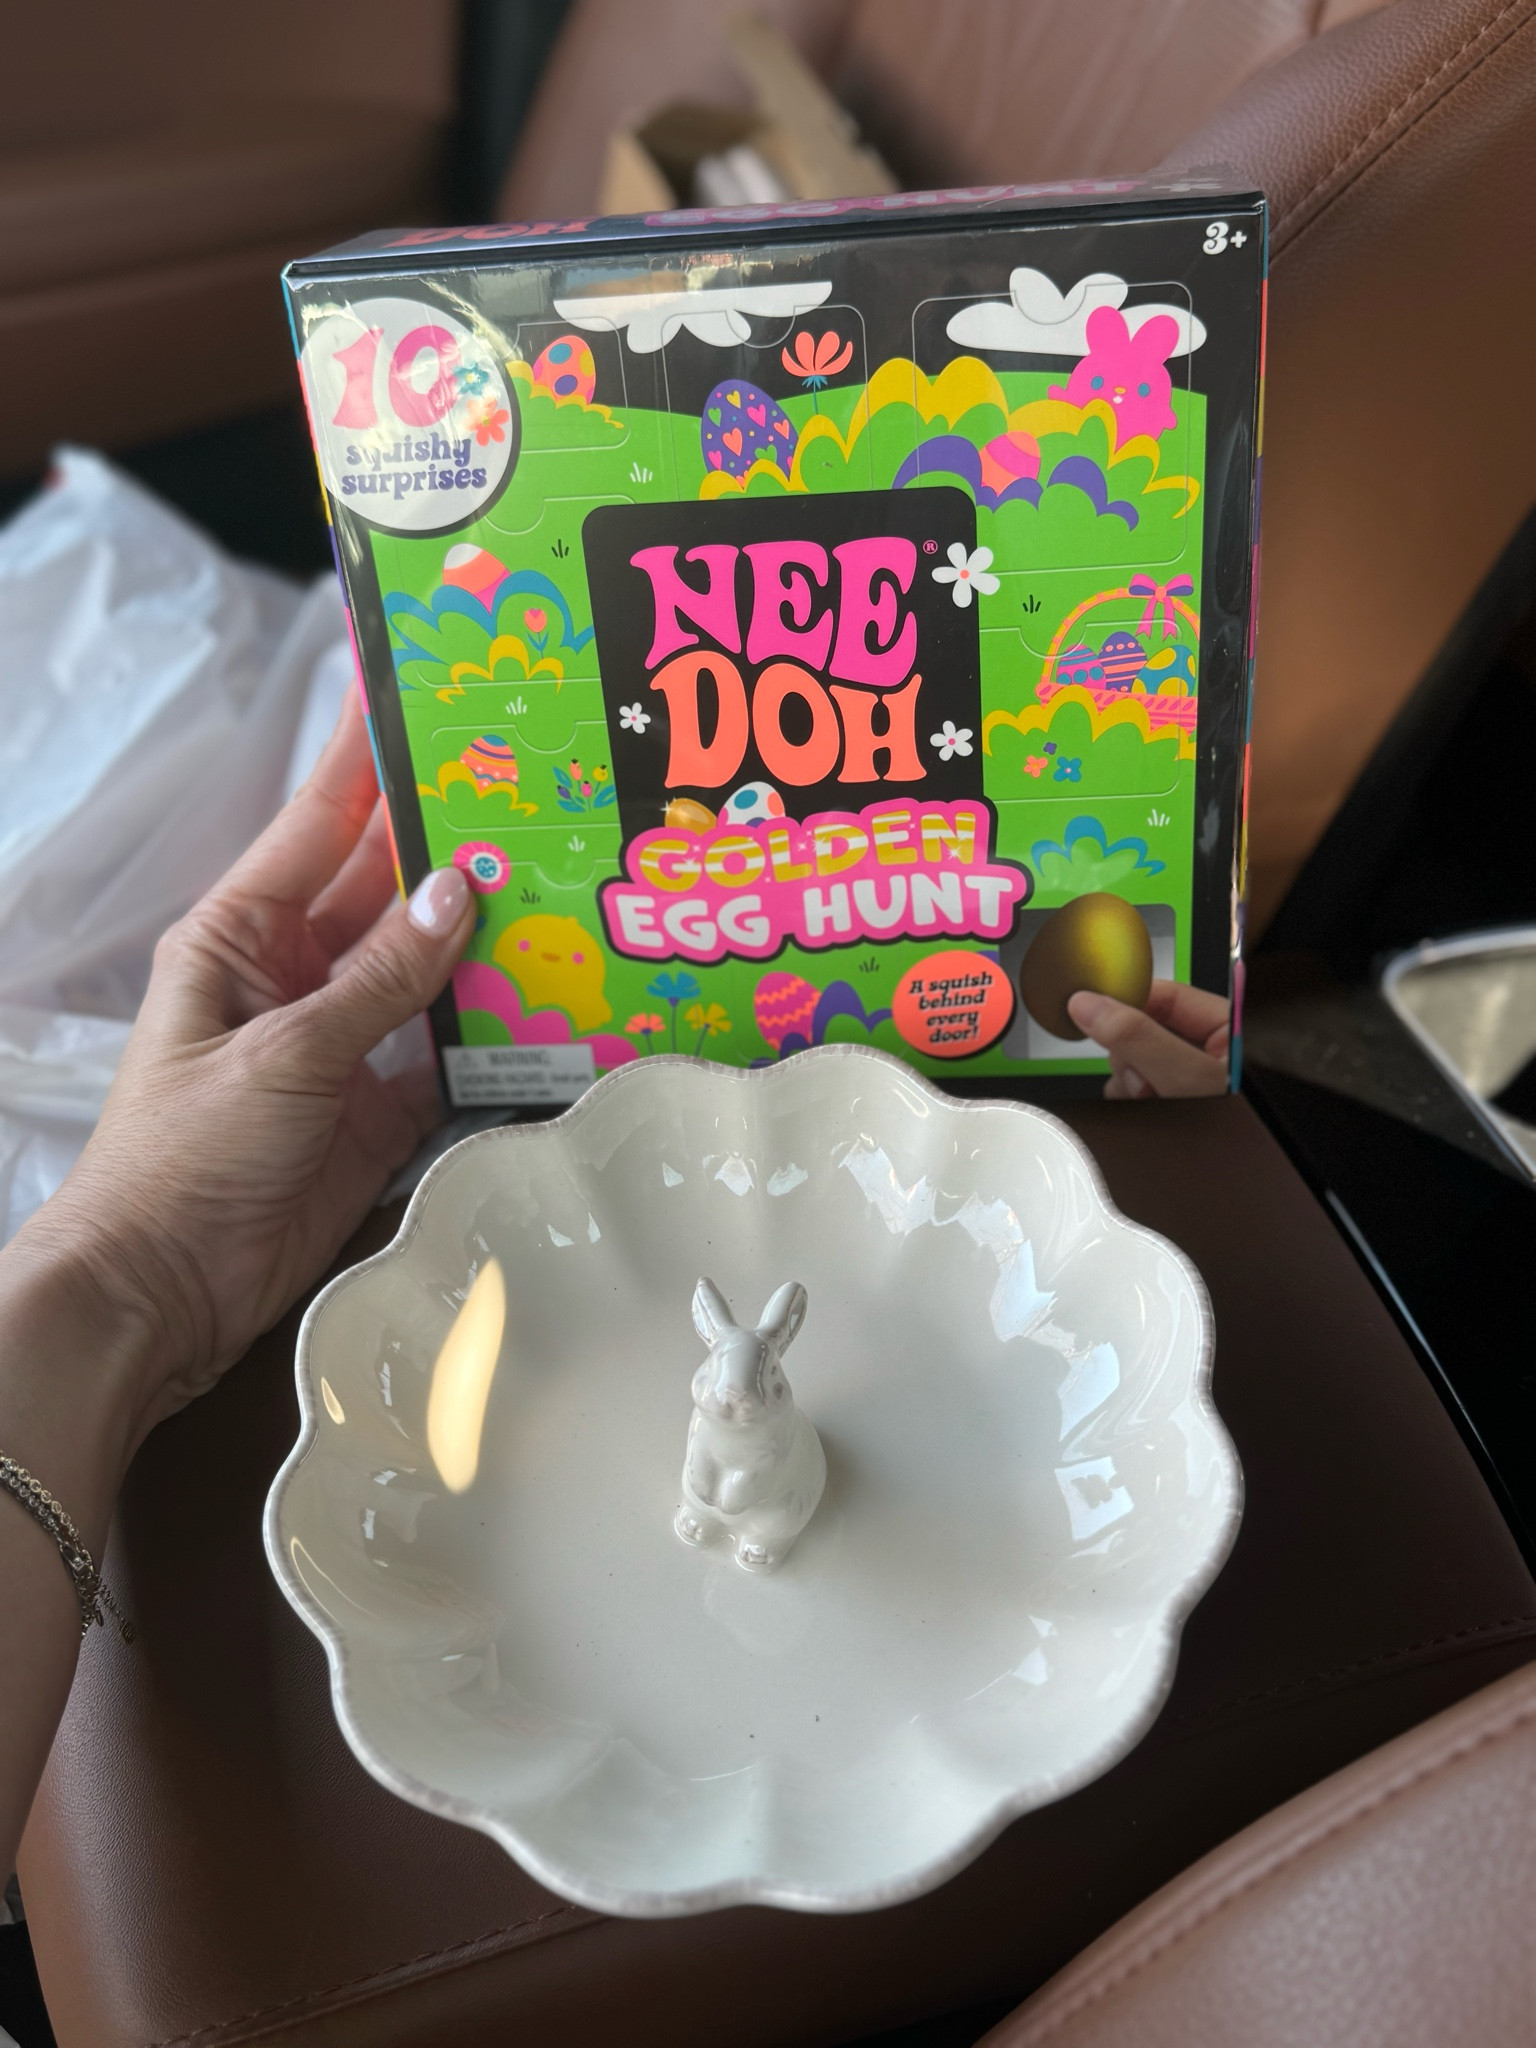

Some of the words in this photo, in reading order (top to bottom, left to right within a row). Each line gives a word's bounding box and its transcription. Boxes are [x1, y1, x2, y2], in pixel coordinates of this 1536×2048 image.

[1202, 222, 1248, 255] 3+
[332, 325, 463, 430] 10
[346, 432, 472, 472] squishy
[341, 463, 488, 500] surprises
[630, 537, 917, 687] NEE
[649, 650, 927, 789] DOH
[639, 810, 976, 893] GOLDEN
[616, 894, 771, 951] EGG
[803, 871, 1013, 937] HUNT
[909, 980, 922, 994] A
[928, 971, 992, 994] squish
[919, 989, 985, 1010] behind
[927, 1011, 979, 1027] every
[929, 1026, 978, 1043] door!
